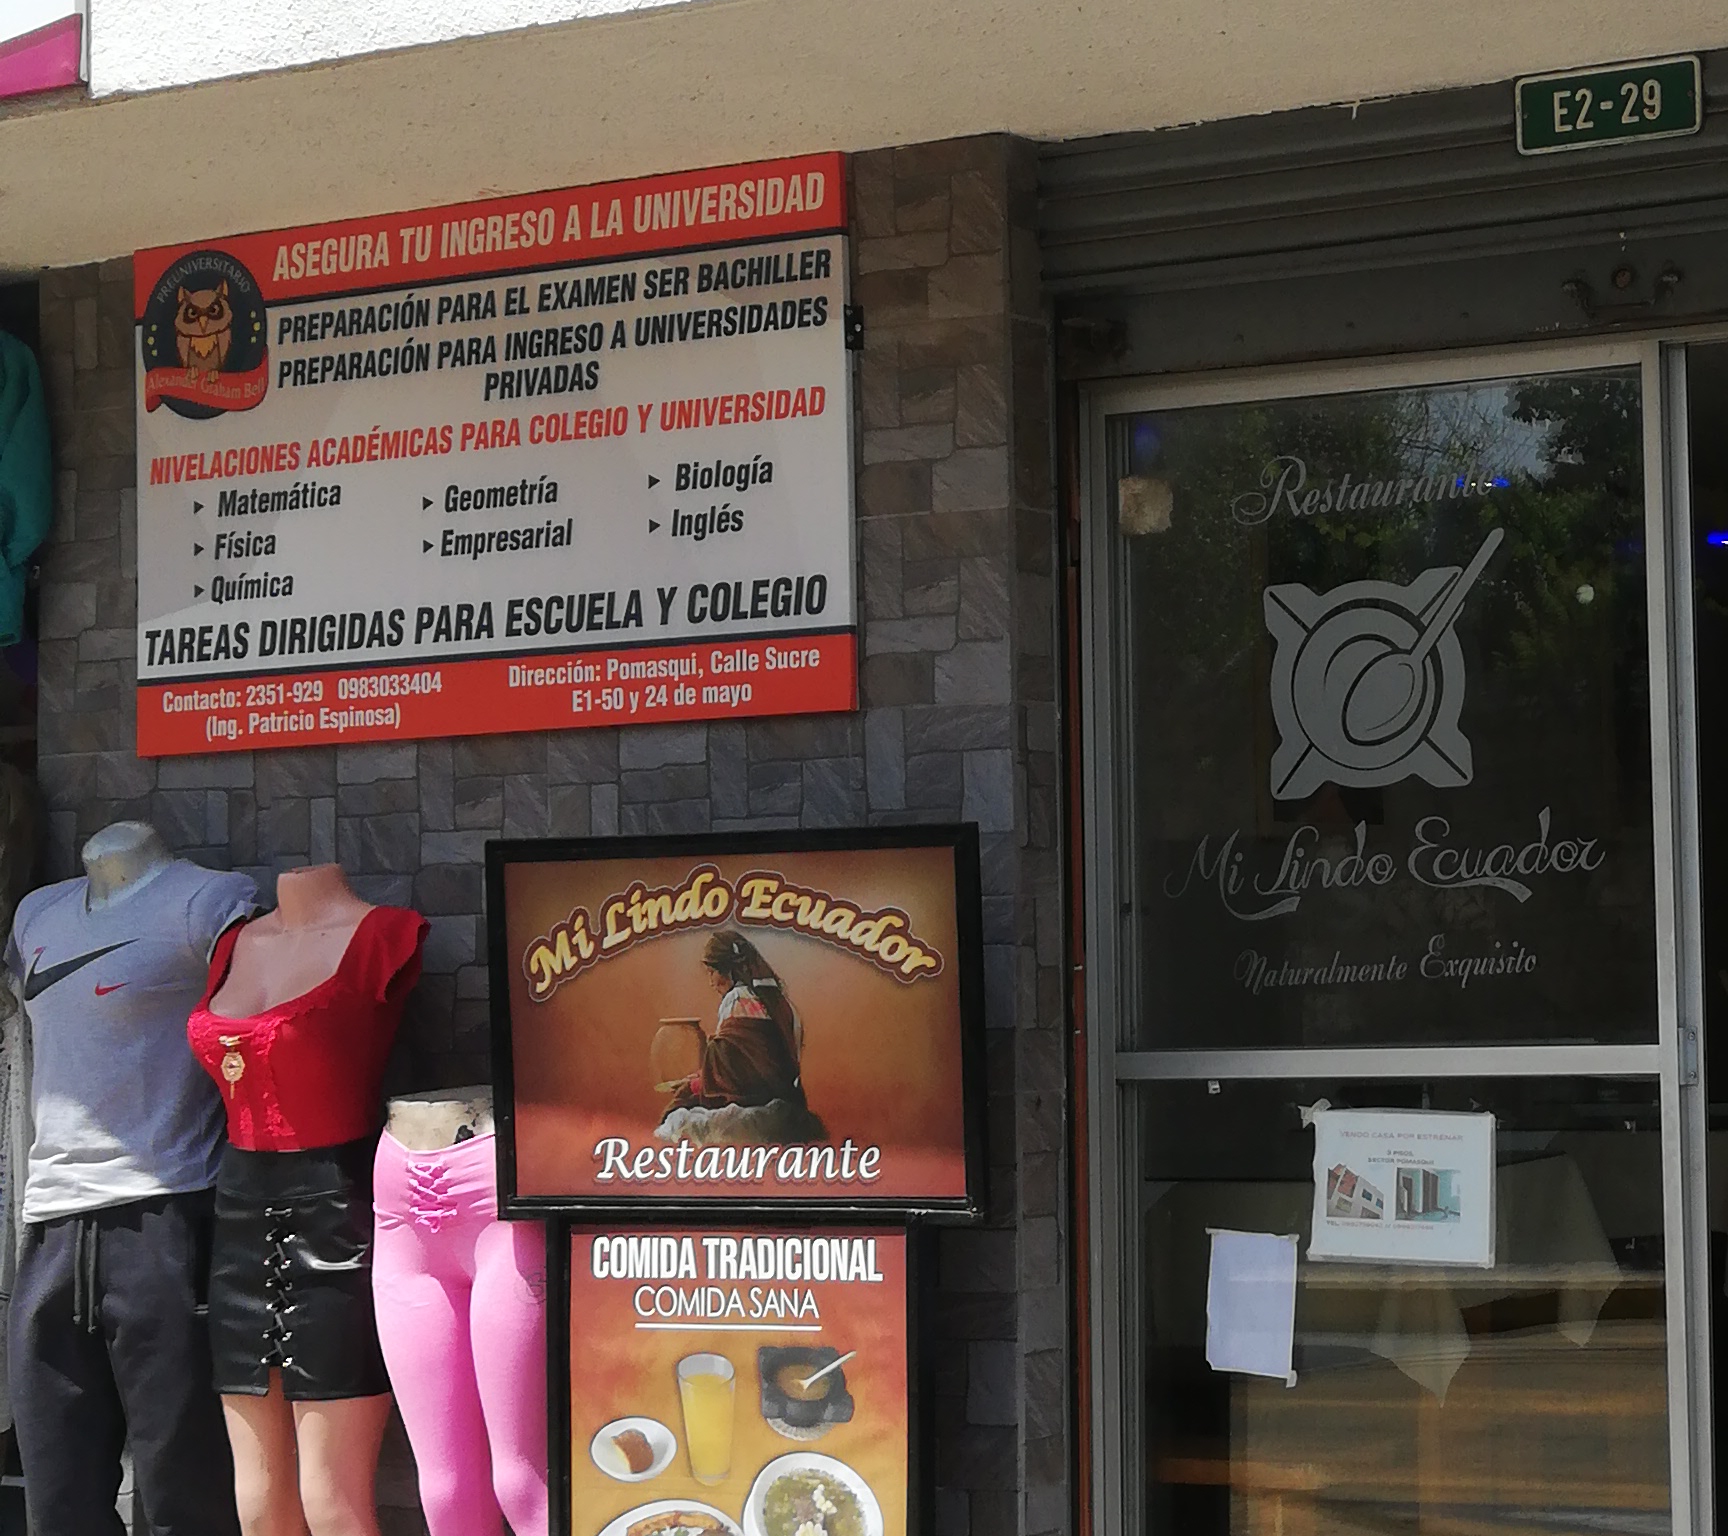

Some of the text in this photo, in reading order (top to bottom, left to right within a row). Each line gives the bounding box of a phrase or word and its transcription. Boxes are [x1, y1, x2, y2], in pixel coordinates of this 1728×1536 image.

[1552, 78, 1662, 133] E2-29
[273, 172, 825, 282] ASEGURA TU INGRESO A LA UNIVERSIDAD
[278, 249, 831, 345] PREPARACIÓN PARA EL EXAMEN SER BACHILLER
[278, 296, 828, 388] PREPARACIÓN PARA INGRESO A UNIVERSIDADES
[244, 378, 265, 399] Bell
[483, 360, 599, 401] PRIVADAS
[150, 386, 826, 485] NIVELACIONES ACADÉMICAS PARA COLEGIO Y UNIVERSIDAD
[217, 455, 773, 518] Matemática Geometría Biología
[1230, 455, 1493, 525] Restaurante
[214, 503, 744, 560] Física Empresarial Inglés
[211, 573, 294, 604] Química
[145, 574, 827, 666] TAREAS DIRIGIDAS PARA ESCUELA Y COLEGIO
[163, 671, 442, 714] Contacto: 2351-929 0983033404
[508, 646, 820, 687] Dirección: Pomasqui, Calle Sucre
[206, 703, 400, 742] (Ing. Patricio Espinosa)
[572, 683, 752, 713] E1-50 y 24 de mayo
[1254, 820, 1396, 895] Lindo
[1408, 806, 1606, 902] Ecuador
[529, 870, 937, 994] Mi Lindo Ecuador
[1234, 934, 1537, 996] Naturalmente Exquisito
[593, 1136, 882, 1181] Restaurante
[591, 1235, 884, 1282] COMIDA TRADICIONAL
[633, 1284, 820, 1320] COMIDA SANA
